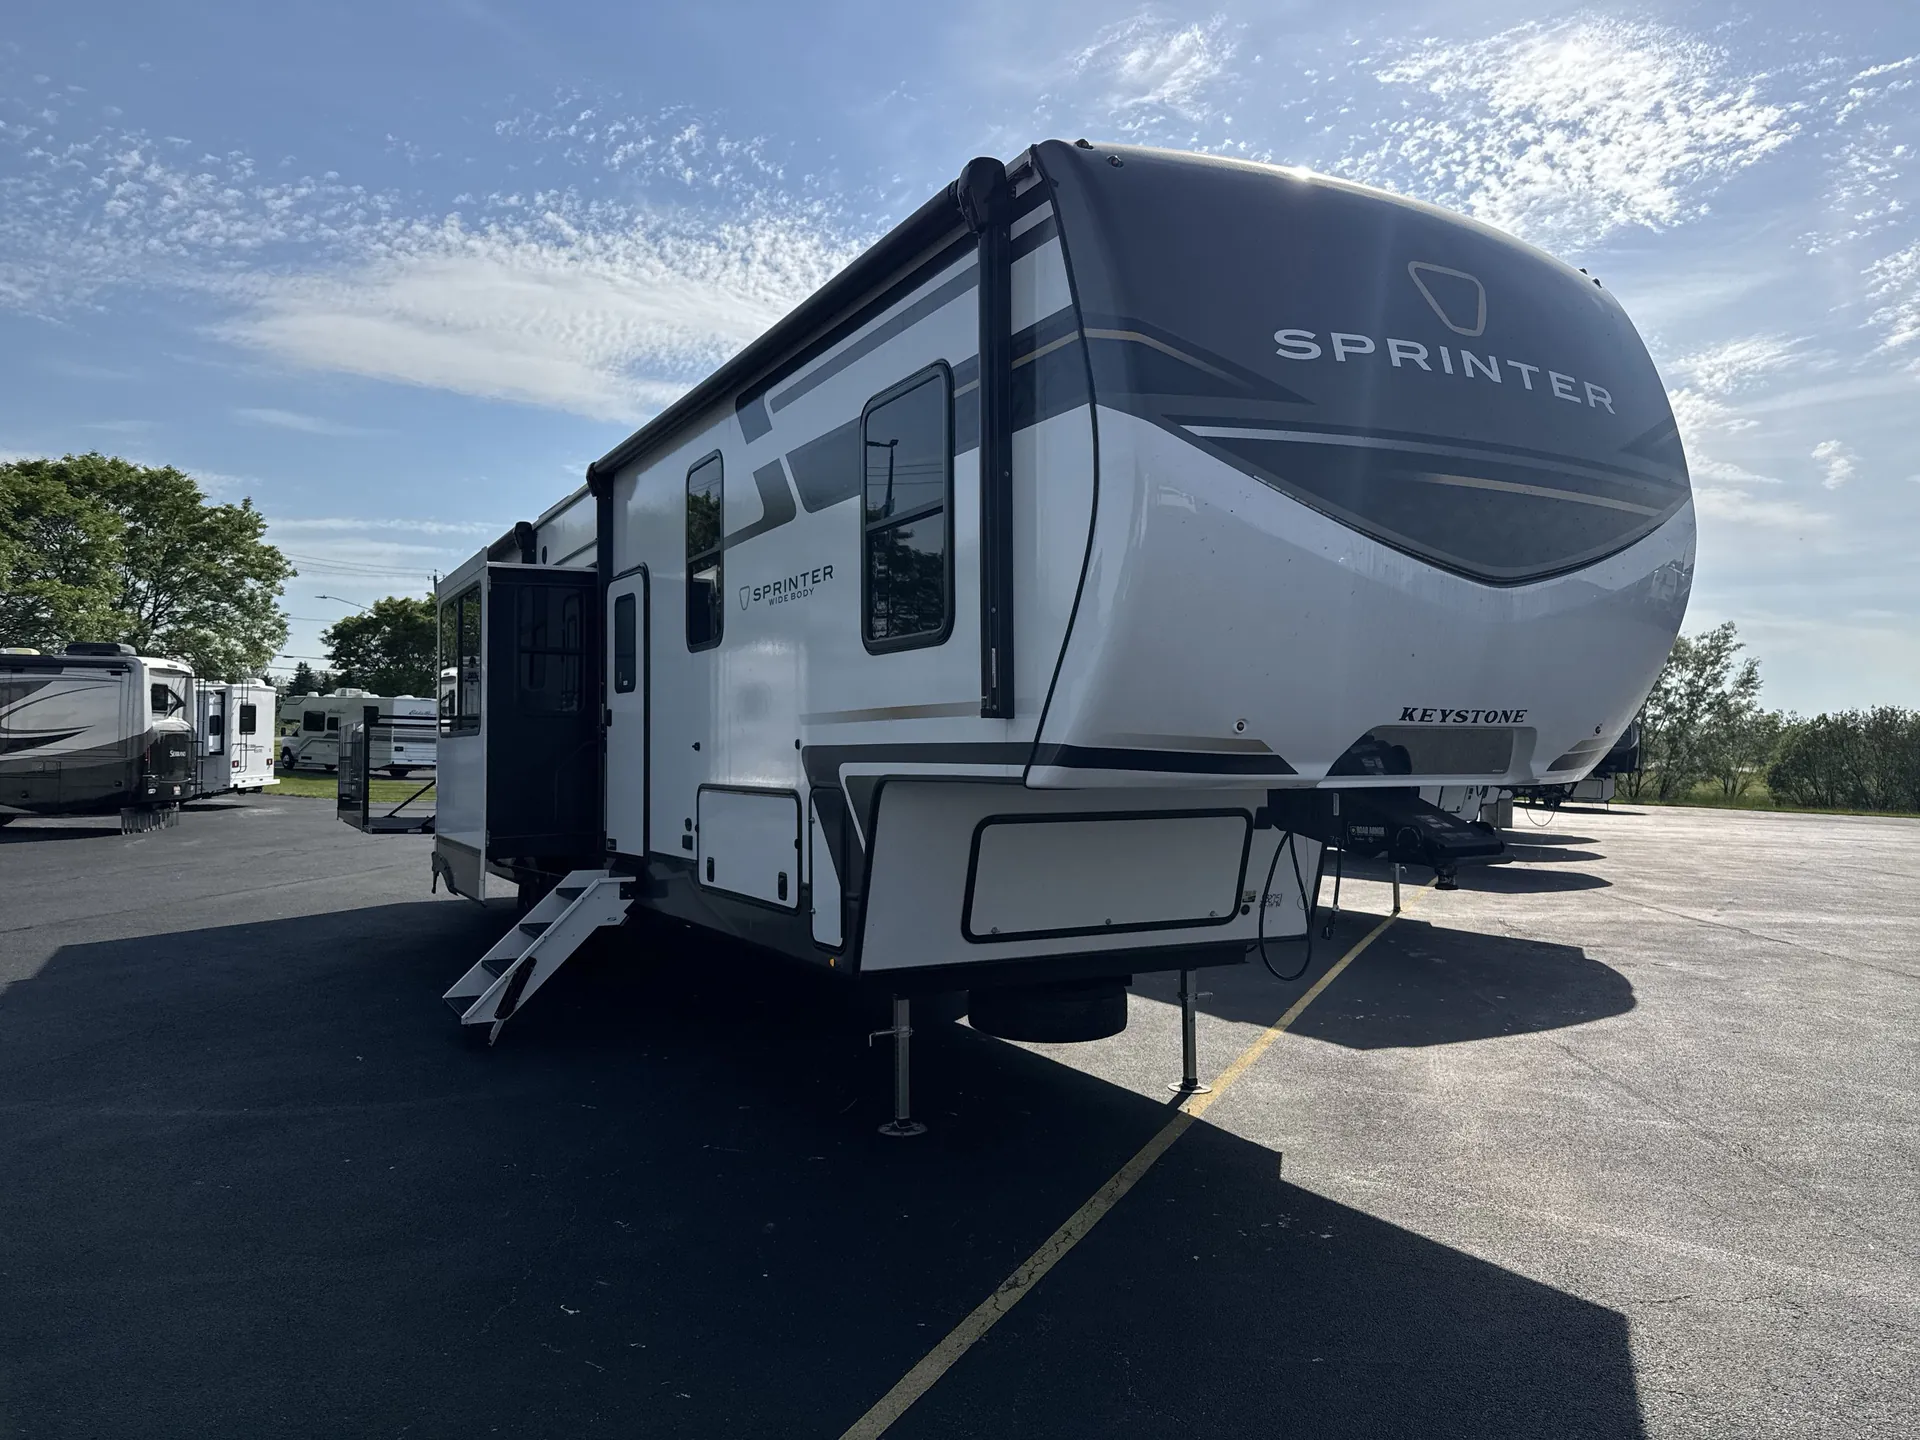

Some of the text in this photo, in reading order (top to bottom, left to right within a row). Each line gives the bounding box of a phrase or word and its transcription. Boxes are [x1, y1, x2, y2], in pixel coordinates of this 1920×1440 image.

[1273, 328, 1616, 415] SPRINTER
[753, 564, 834, 602] SPRINTER
[768, 587, 815, 607] WIDE BODY
[1398, 706, 1528, 724] KEYSTONE
